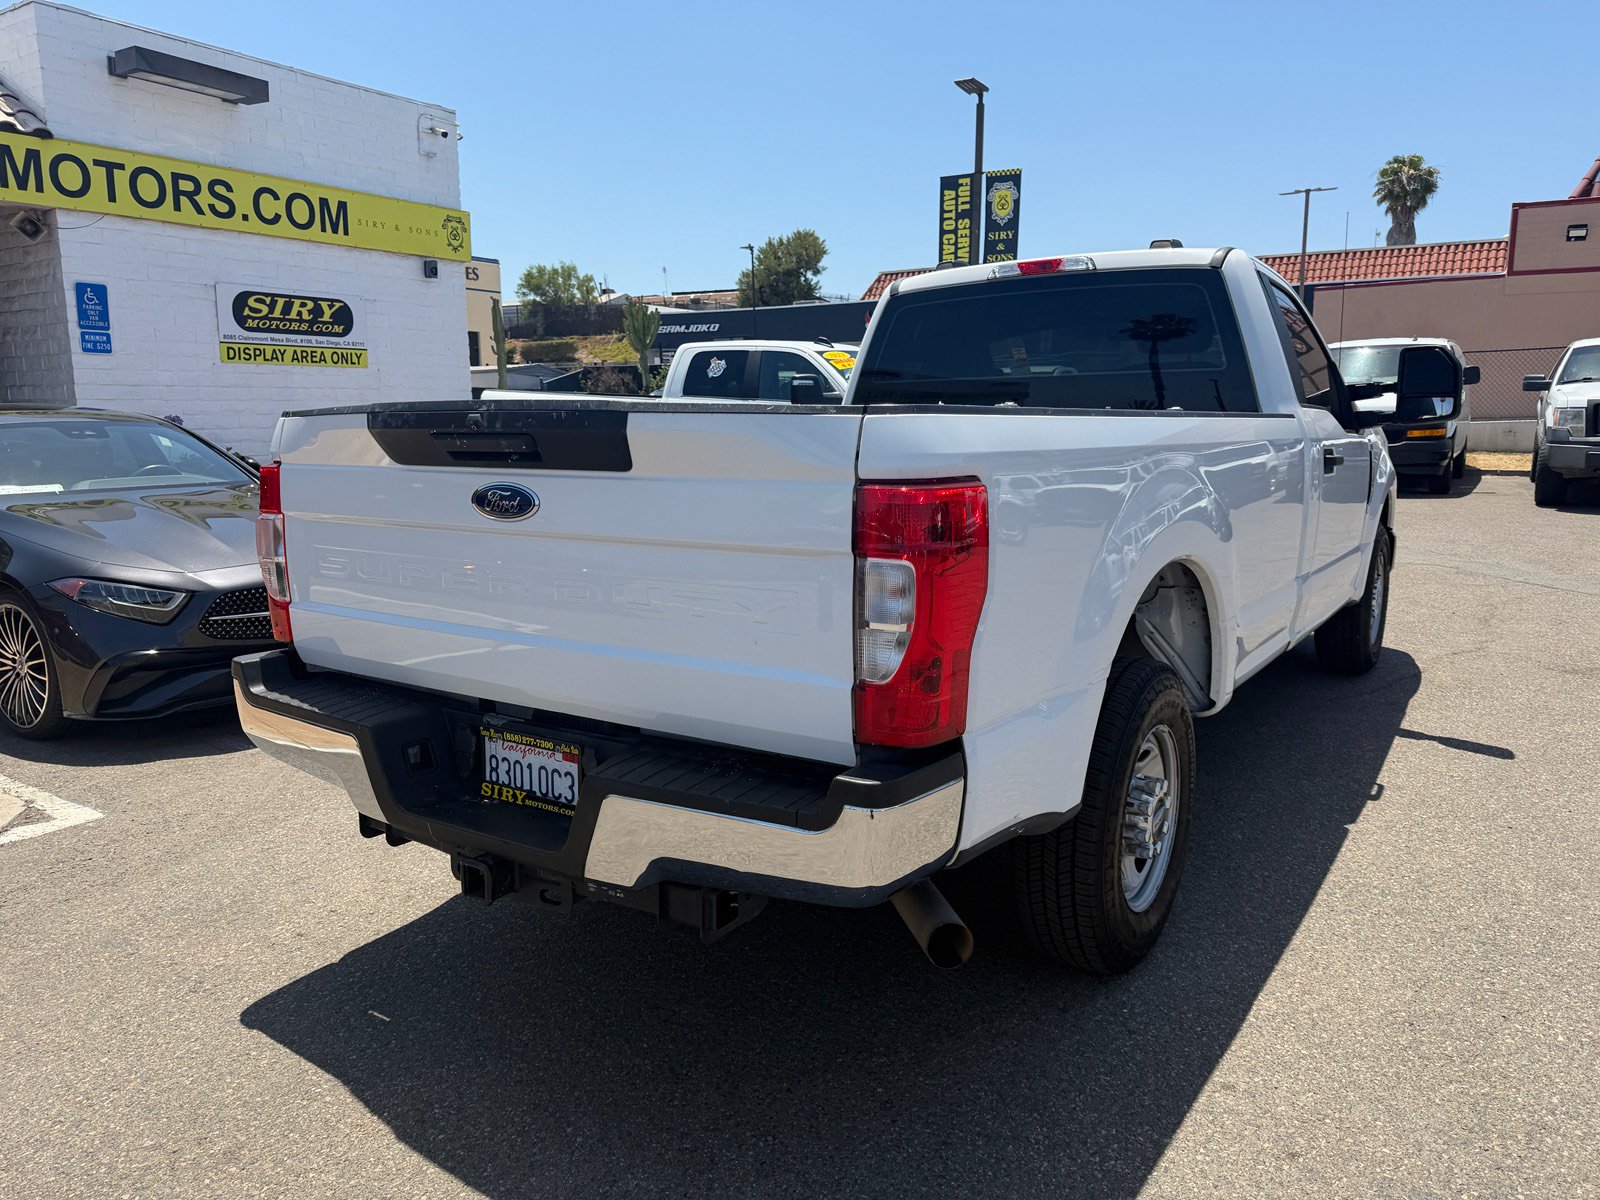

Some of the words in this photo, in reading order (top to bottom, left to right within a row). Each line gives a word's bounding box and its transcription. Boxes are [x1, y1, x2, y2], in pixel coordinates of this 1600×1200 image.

[0, 143, 349, 236] MOTORS.COM
[958, 177, 971, 212] FULL
[943, 190, 956, 230] AUTO
[357, 218, 386, 229] SIRY
[408, 226, 438, 237] SONS
[988, 230, 1015, 240] SIRY
[986, 253, 1014, 262] SONS
[465, 266, 480, 281] ES
[243, 295, 344, 322] SIRY
[244, 318, 345, 333] MOTORS.COM
[657, 323, 720, 334] SAMJOKO
[84, 334, 107, 342] MINIMUM
[96, 343, 111, 351] $250
[222, 333, 237, 341] 8085
[237, 334, 269, 344] Clairemont
[285, 337, 299, 345] Blvd,
[226, 346, 287, 362] DISPLAY
[290, 350, 328, 364] AREA
[330, 352, 363, 366] ONLY
[484, 489, 520, 513] Ford
[318, 553, 531, 601] SUPER
[552, 576, 791, 626] DUTY
[502, 740, 562, 762] California
[503, 731, 521, 744] (858)
[521, 736, 554, 751] 277-7300
[489, 754, 575, 805] 83010C3
[481, 782, 527, 805] SIRY
